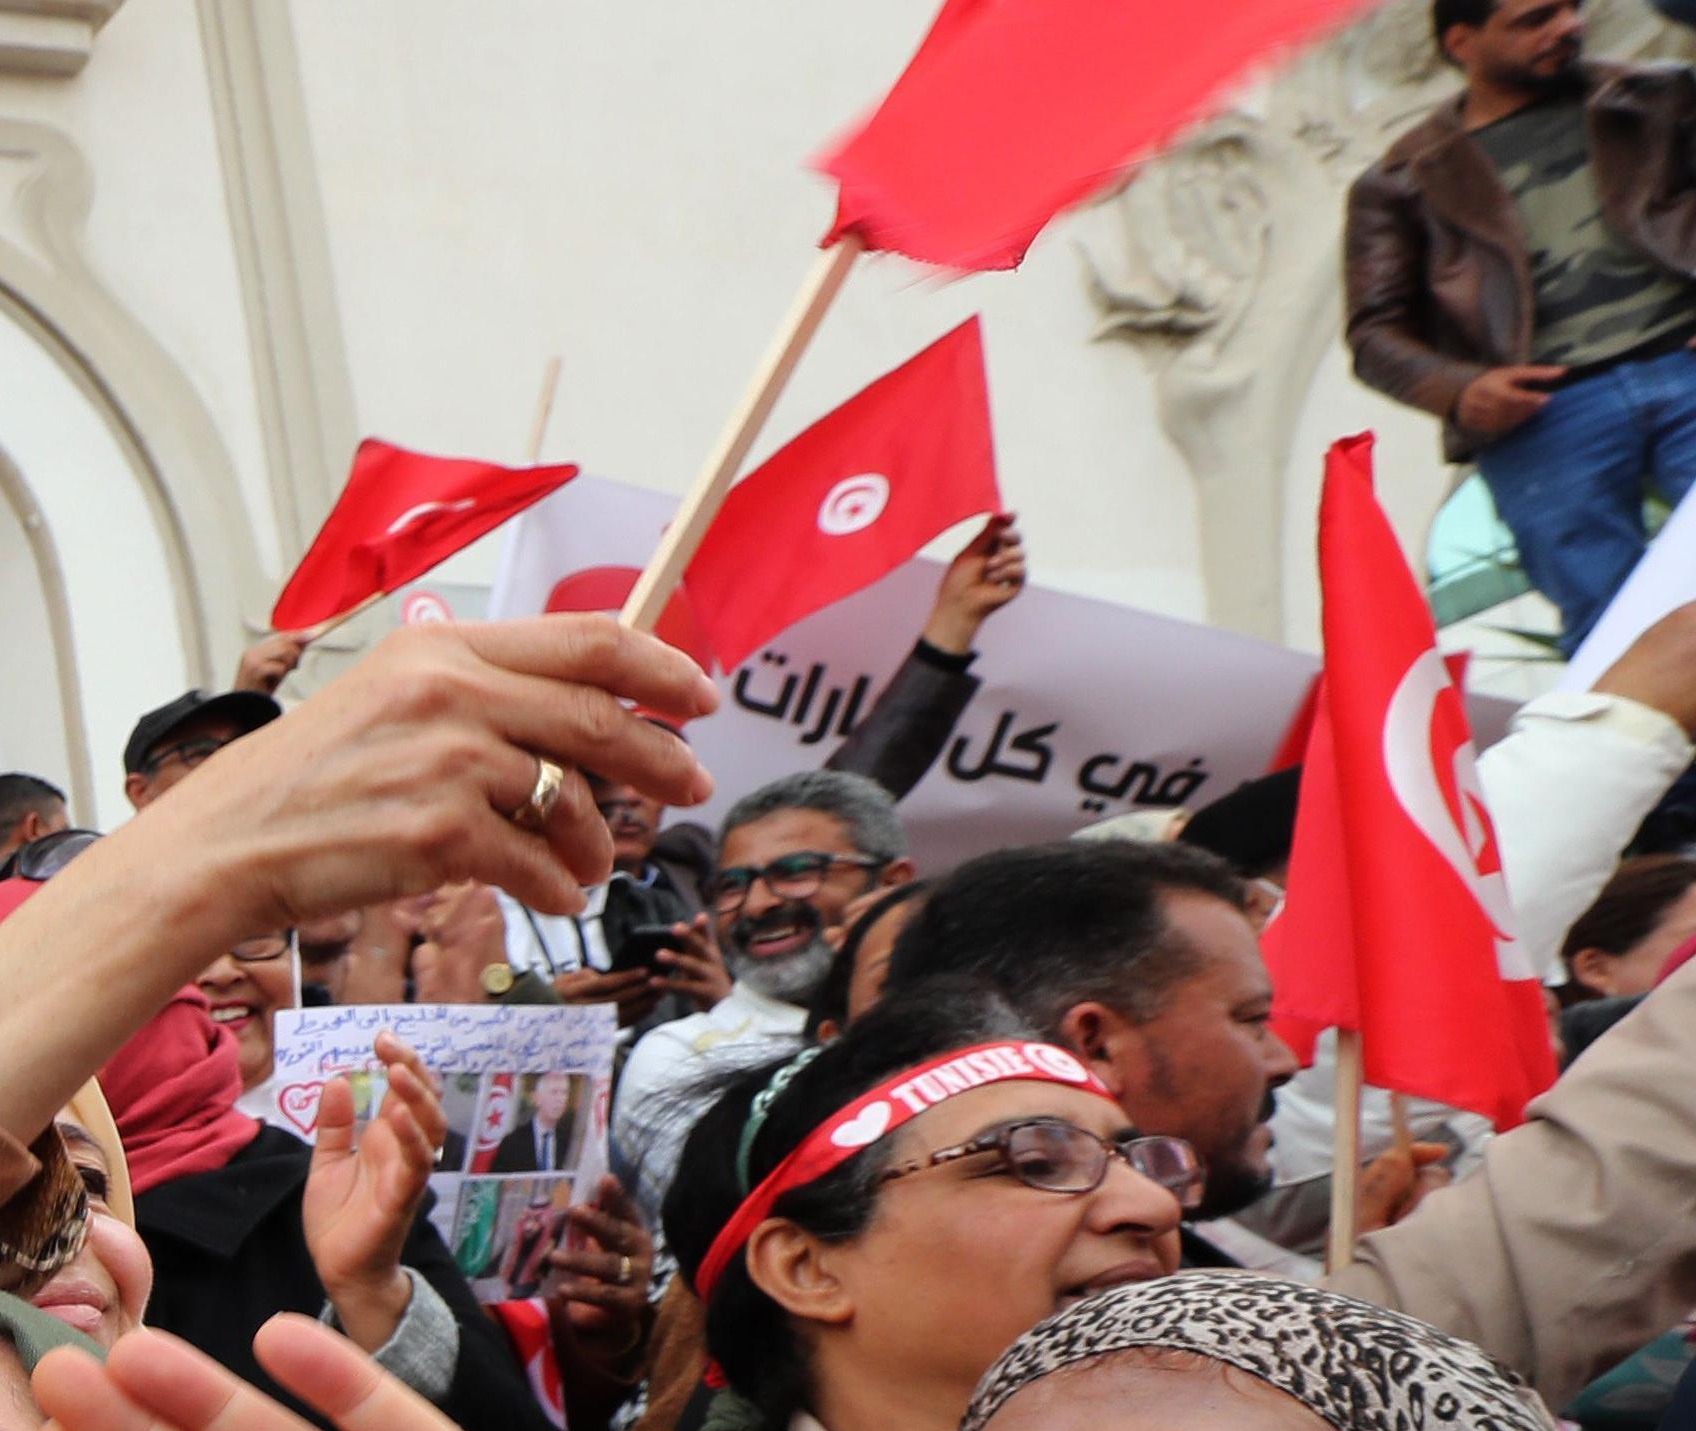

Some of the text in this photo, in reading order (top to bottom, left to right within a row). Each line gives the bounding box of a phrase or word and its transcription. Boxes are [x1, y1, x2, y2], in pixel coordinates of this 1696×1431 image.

[946, 709, 1063, 784] كل
[1078, 753, 1209, 813] في
[889, 1046, 1034, 1114] TUNISIE
